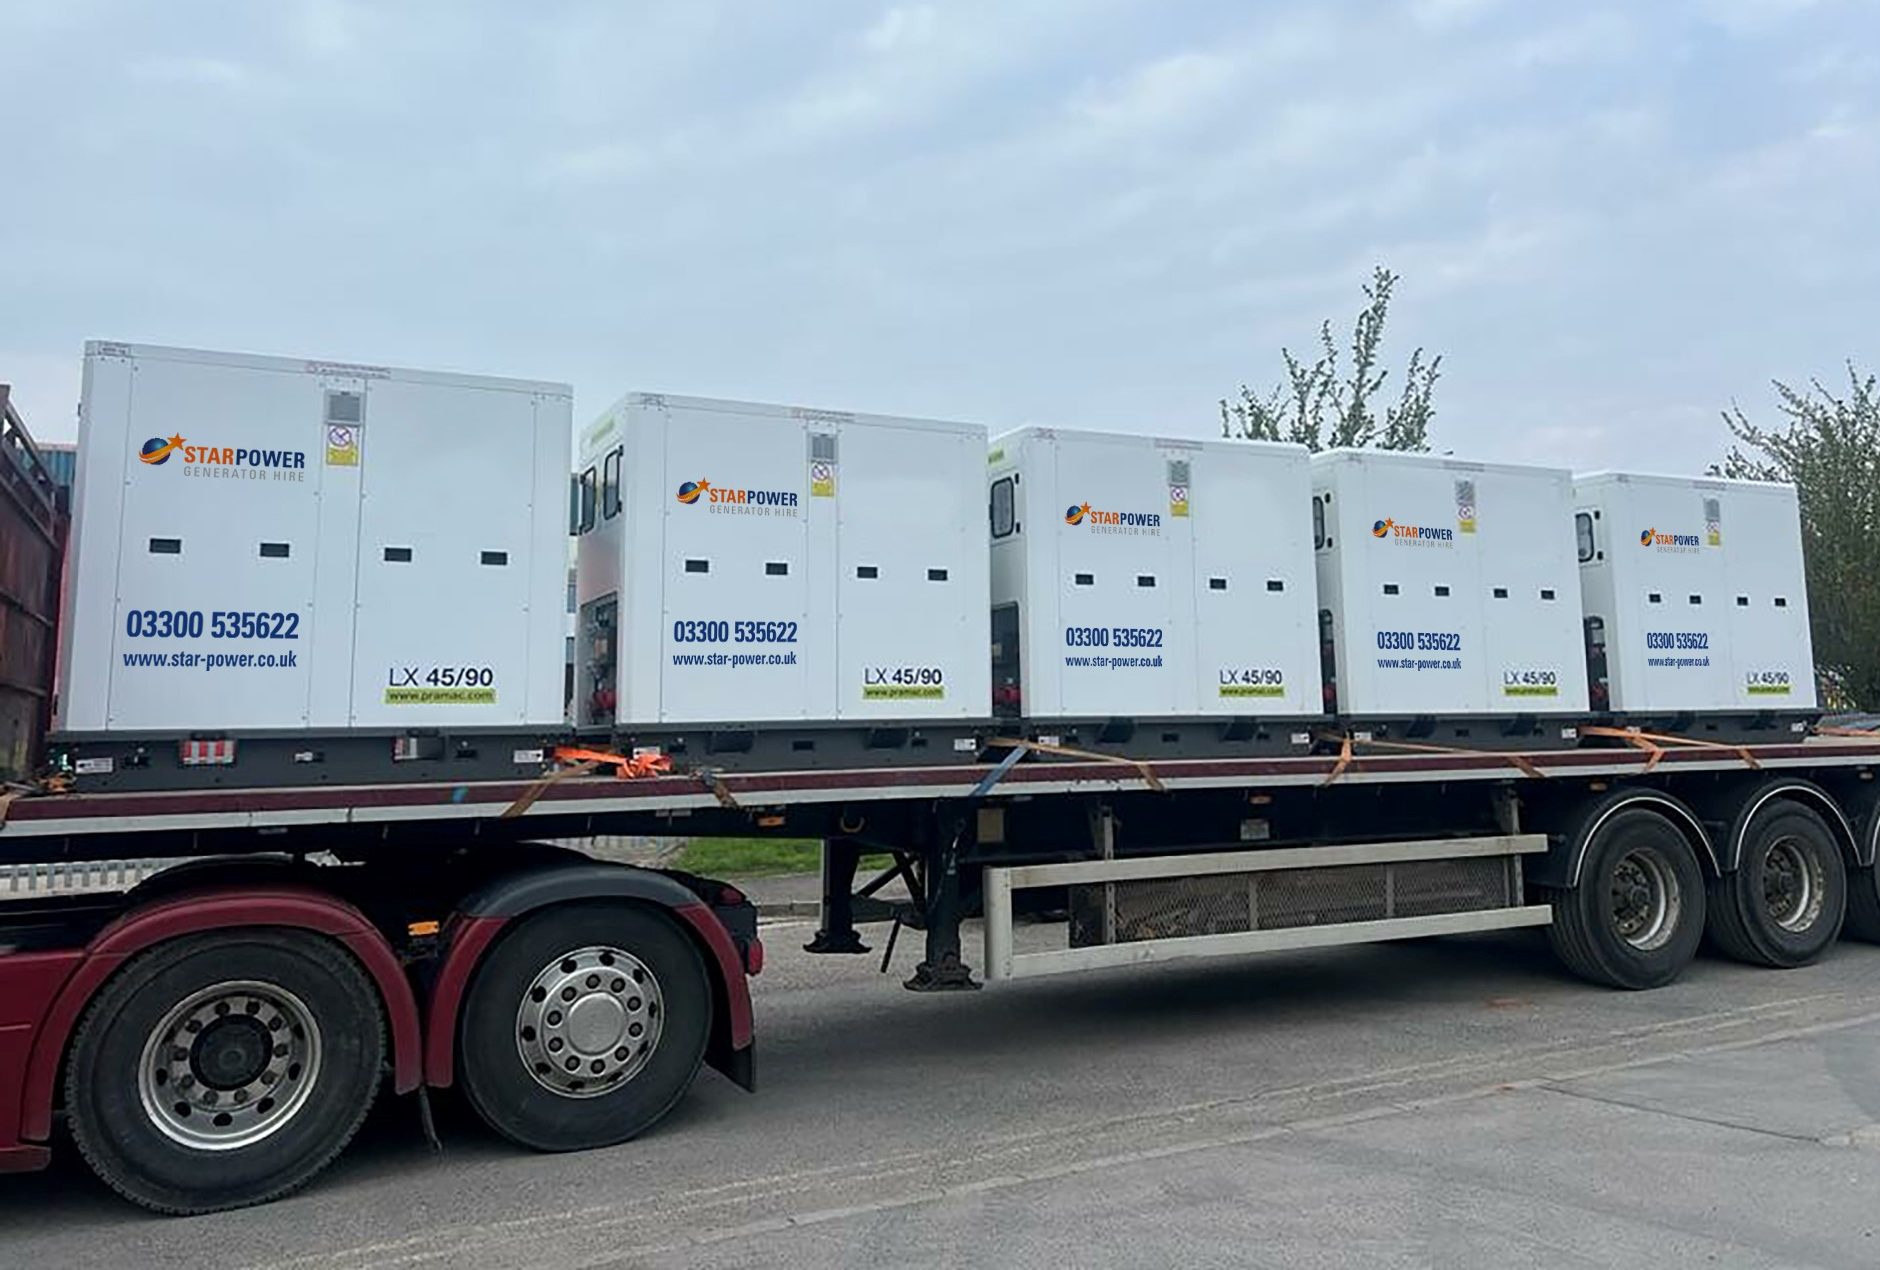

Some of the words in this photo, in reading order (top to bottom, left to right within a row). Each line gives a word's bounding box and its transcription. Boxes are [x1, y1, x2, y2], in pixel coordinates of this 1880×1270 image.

[184, 446, 305, 469] STARPOWER
[183, 466, 266, 480] GENERATOR
[273, 471, 304, 482] HIRE
[709, 488, 798, 507] STARPOWER
[709, 505, 770, 516] GENERATOR
[774, 508, 798, 517] HIRE
[1090, 511, 1161, 527] STARPOWER
[1090, 525, 1139, 536] GENERATOR
[1142, 528, 1160, 537] HIRE
[1394, 525, 1453, 541] STARPOWER
[126, 610, 204, 638] 03300
[211, 611, 300, 639] 535622
[674, 620, 729, 643] 03300
[734, 621, 798, 643] 535622
[1066, 627, 1109, 647] 03300
[1112, 628, 1163, 648] 535622
[1377, 631, 1414, 650] 03300
[1417, 632, 1461, 651] 535622
[1647, 632, 1674, 649] 03300
[1676, 633, 1709, 649] 535622
[123, 650, 297, 671] www.star-power.co.uk
[673, 651, 797, 668] www.star-power.co.uk
[1065, 655, 1163, 670] www.star-power.co.uk
[1377, 657, 1462, 671] www.star-power.co.uk
[389, 668, 418, 686] LX
[426, 668, 493, 686] 45/90
[865, 668, 887, 685] LX
[892, 668, 943, 685] 45/90
[1220, 669, 1238, 684] LX
[1242, 669, 1282, 684] 45/90
[1504, 671, 1520, 685] LX
[389, 691, 493, 701] www.pramac.com
